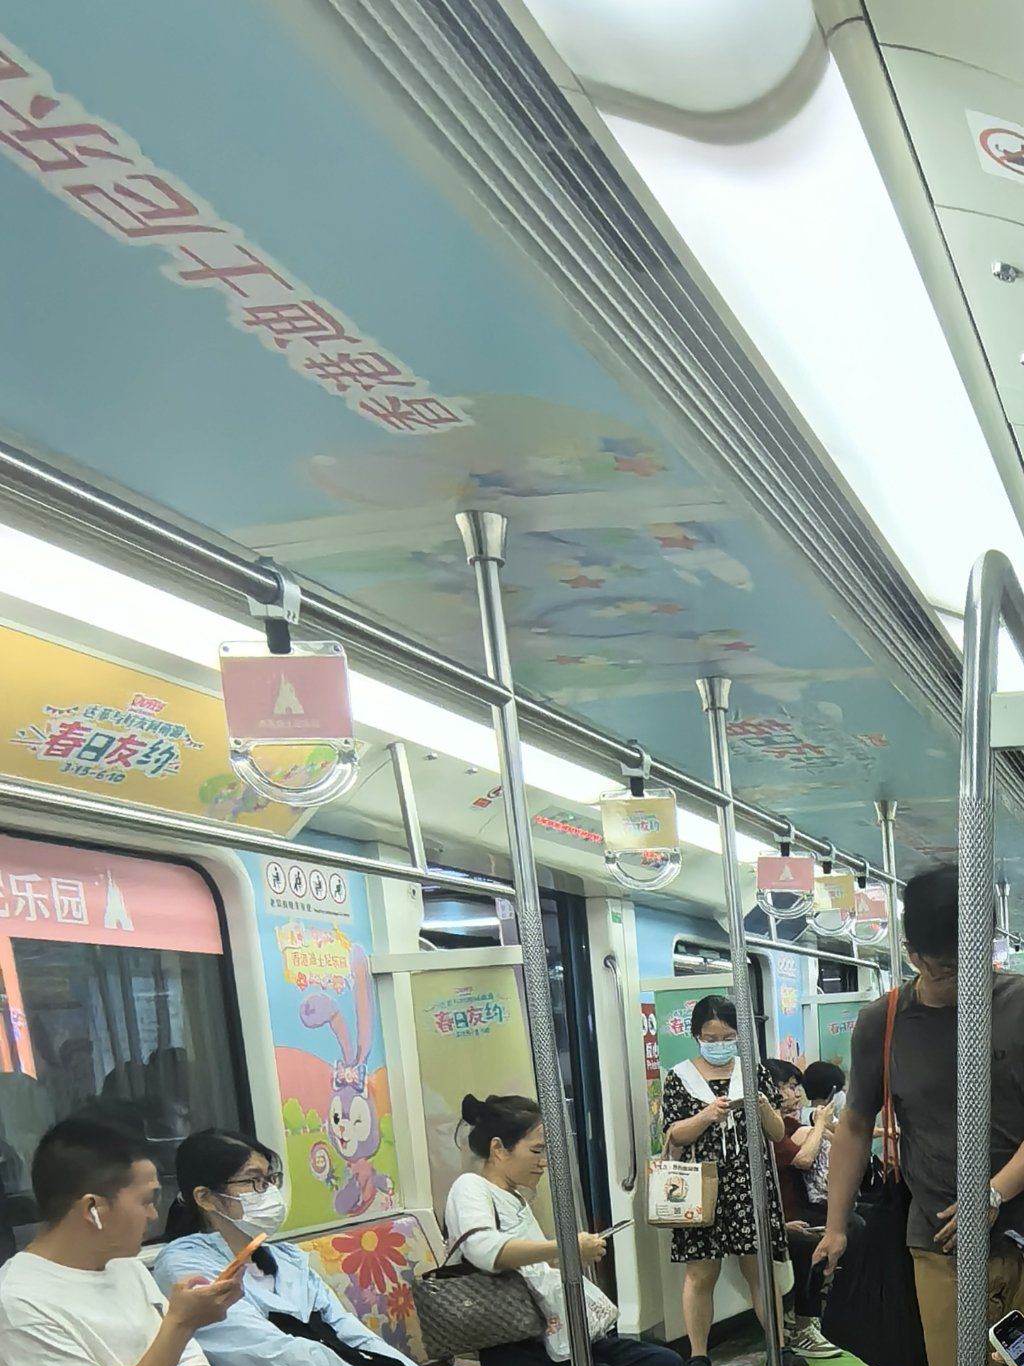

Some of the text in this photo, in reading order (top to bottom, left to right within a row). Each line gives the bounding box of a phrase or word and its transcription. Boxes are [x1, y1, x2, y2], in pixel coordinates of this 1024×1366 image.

[44, 720, 175, 775] 春日友约
[434, 1003, 503, 1033] 春日友约
